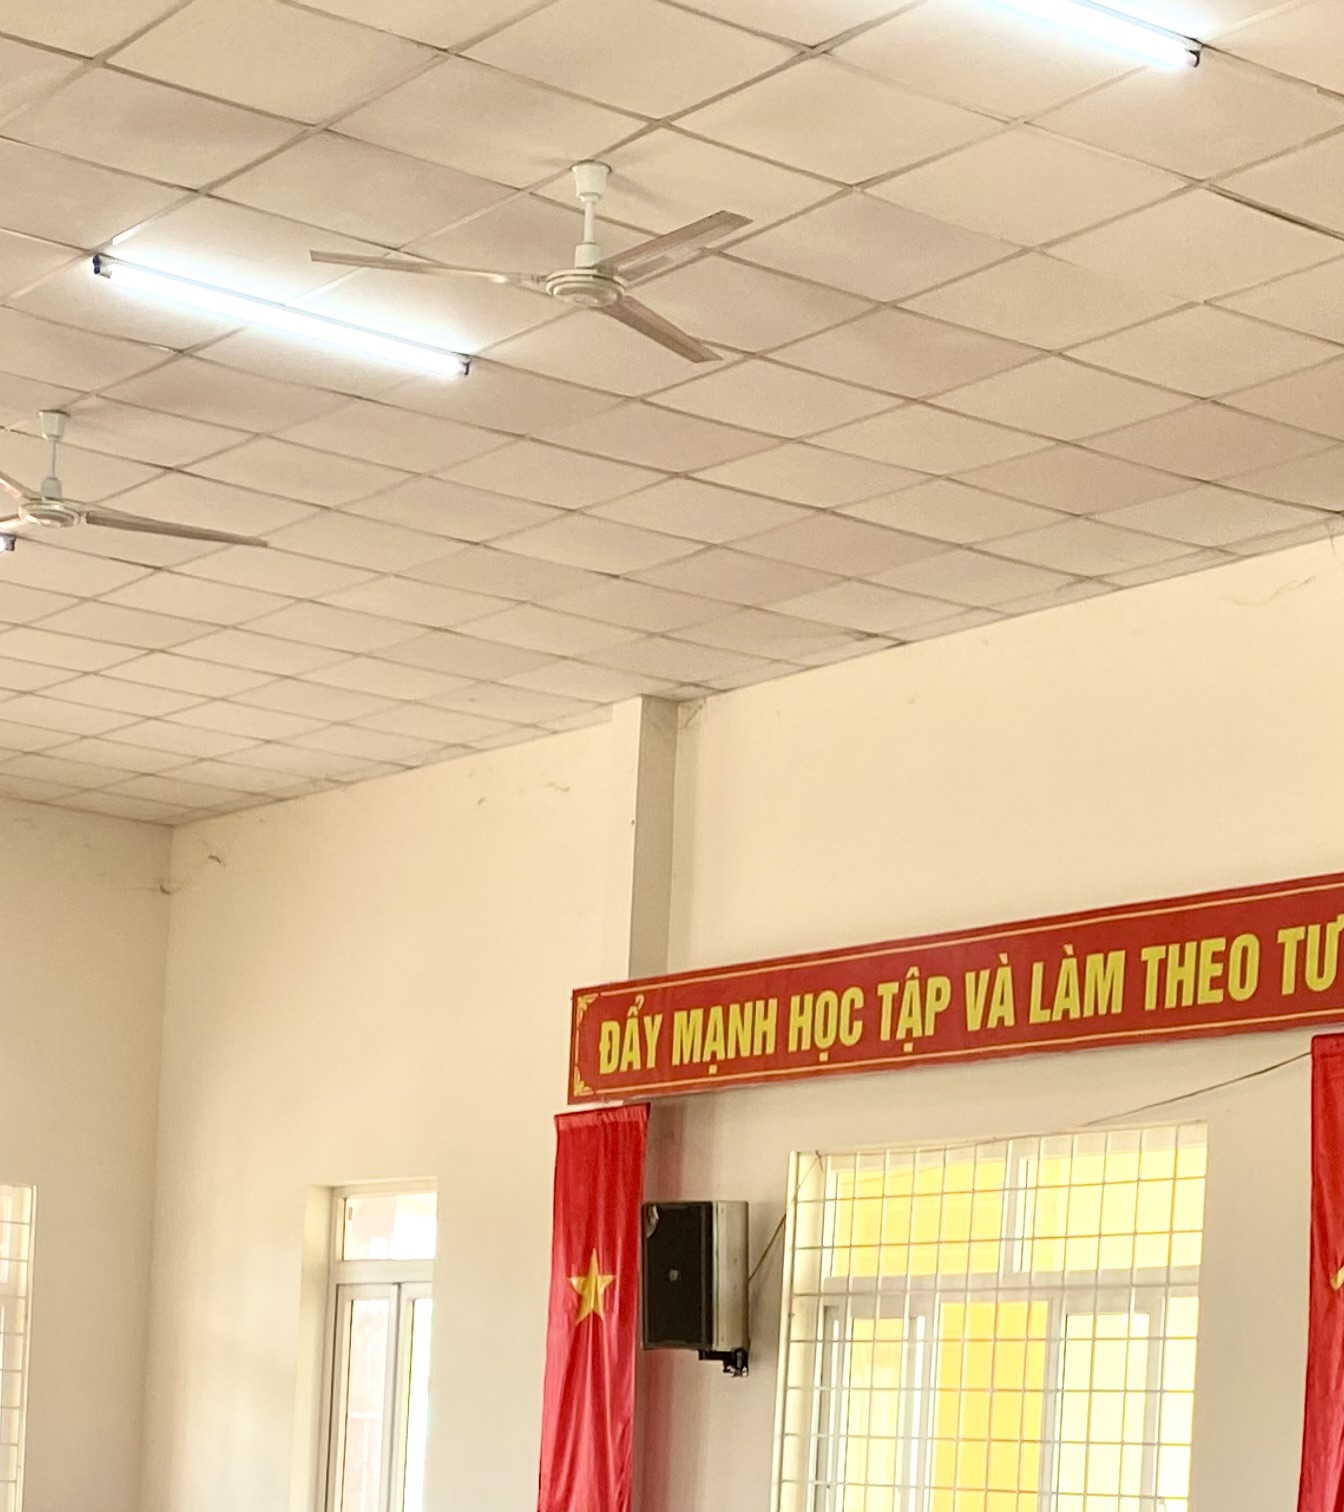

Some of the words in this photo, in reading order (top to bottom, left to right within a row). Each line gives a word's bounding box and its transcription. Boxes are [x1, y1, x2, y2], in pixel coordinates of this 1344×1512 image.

[598, 997, 662, 1074] ĐẨY
[671, 998, 778, 1079] MẠNH
[788, 986, 864, 1064] HỌC
[877, 967, 952, 1061] TẬP
[965, 952, 1016, 1031] VÀ
[1029, 943, 1125, 1024] LÀM
[1141, 933, 1260, 1010] THEO
